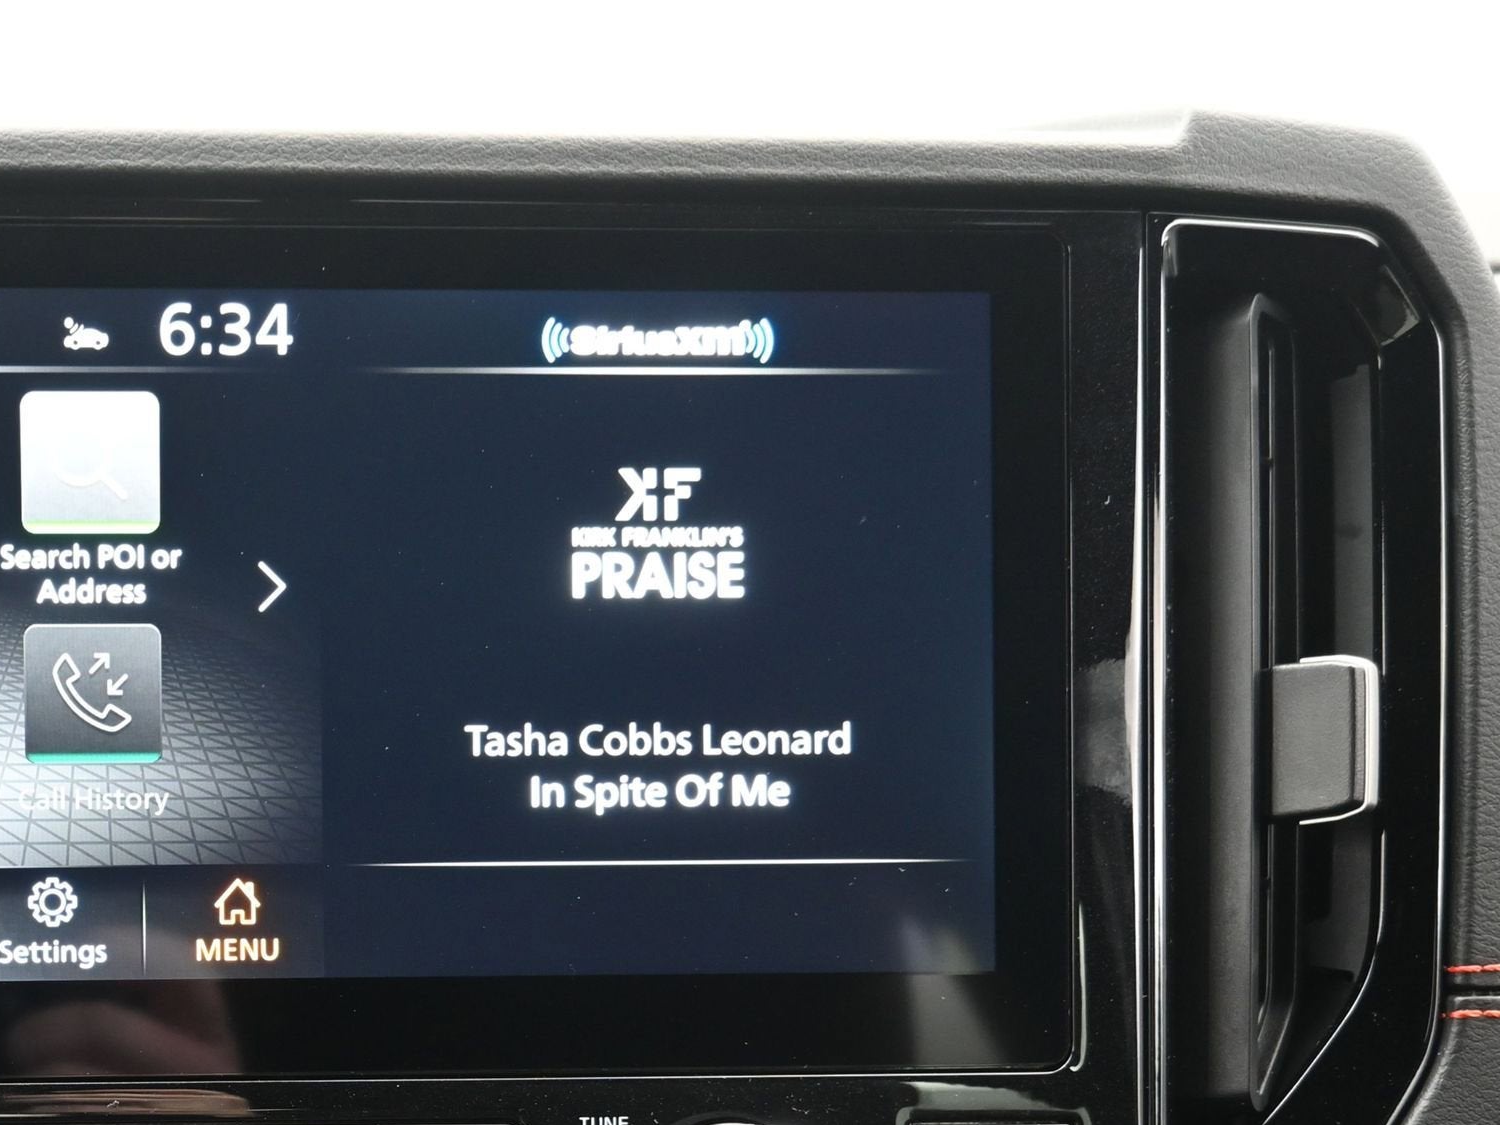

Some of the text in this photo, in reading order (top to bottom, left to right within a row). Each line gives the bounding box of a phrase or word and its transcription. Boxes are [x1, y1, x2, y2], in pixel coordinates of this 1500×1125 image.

[158, 302, 294, 356] 6:34
[0, 543, 182, 570] Search POI or
[36, 578, 146, 604] Address
[572, 550, 745, 600] PRAISE
[464, 720, 851, 757] Tasha Cobbs Leonard
[19, 787, 170, 816] Call History
[530, 773, 792, 815] In Spite Of Me
[195, 937, 280, 962] MENU
